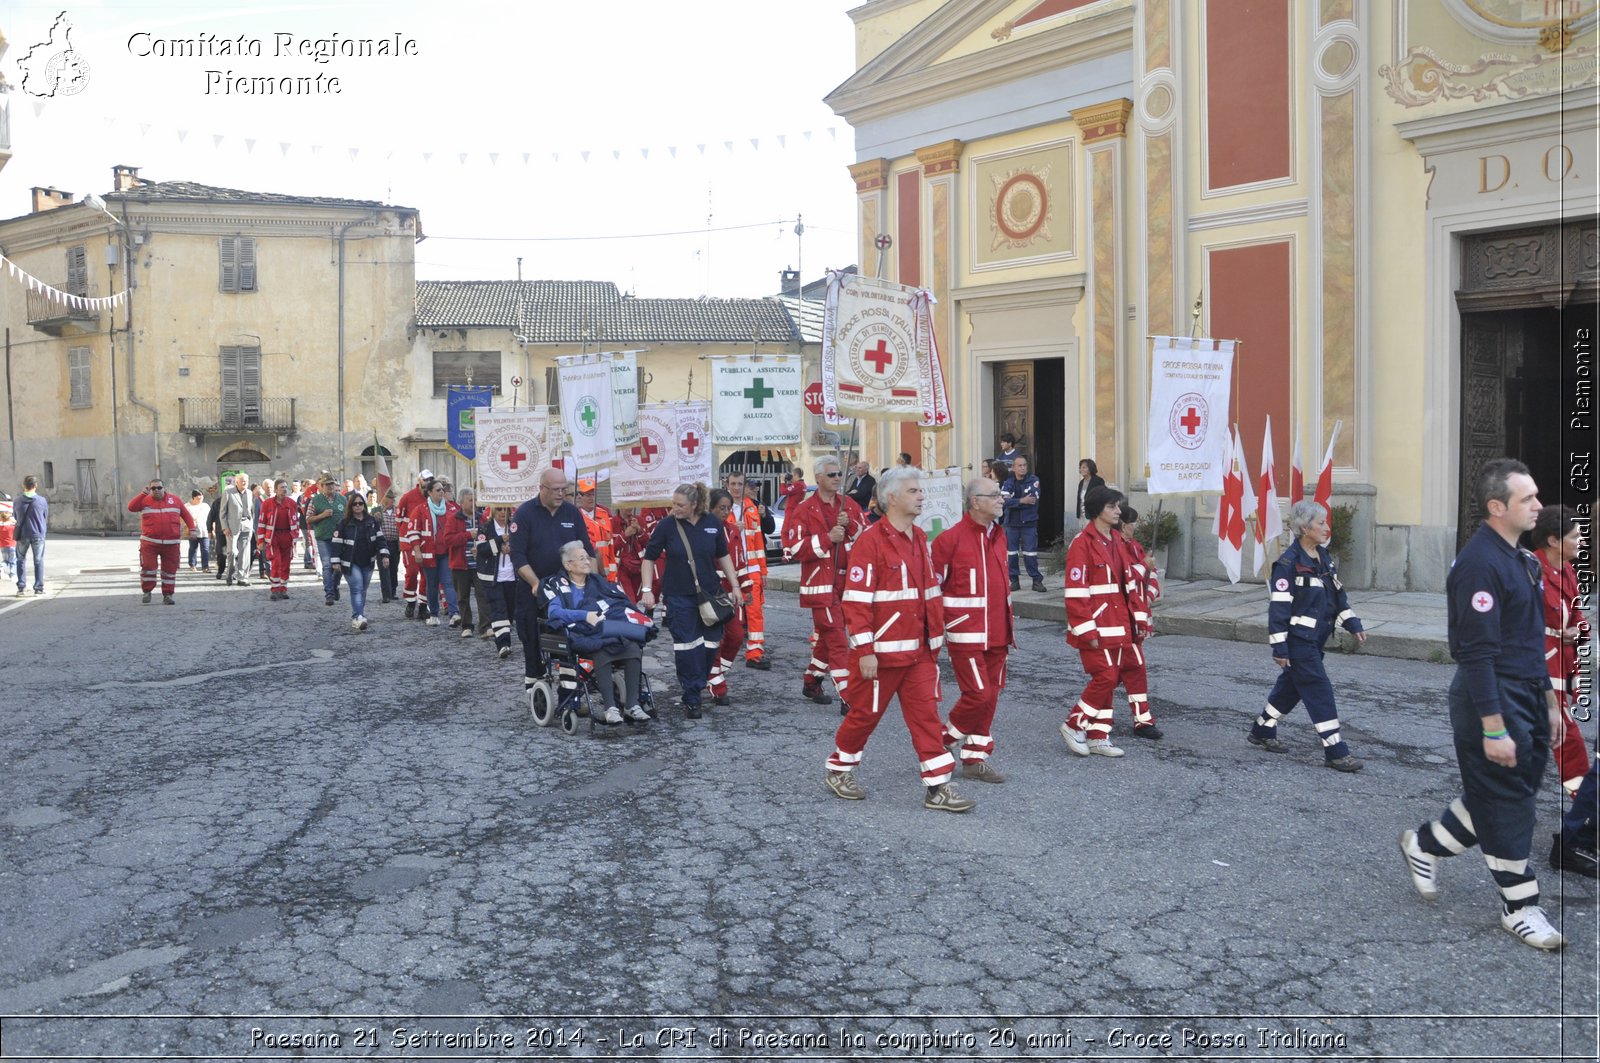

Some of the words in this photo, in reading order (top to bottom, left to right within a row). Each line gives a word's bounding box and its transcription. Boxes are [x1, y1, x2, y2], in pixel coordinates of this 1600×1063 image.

[838, 313, 860, 341] CROCE
[860, 307, 890, 319] ROSSA
[611, 365, 631, 373] TENZA
[756, 366, 796, 374] ASSISTENZA
[613, 387, 636, 395] VERDE
[805, 391, 824, 406] STO
[838, 391, 876, 404] COMITATO
[763, 434, 799, 442] SOCCORSO
[1178, 472, 1203, 481] BARGE
[524, 485, 540, 493] MEL
[480, 493, 517, 501] COMITATO
[520, 493, 536, 501] LOC
